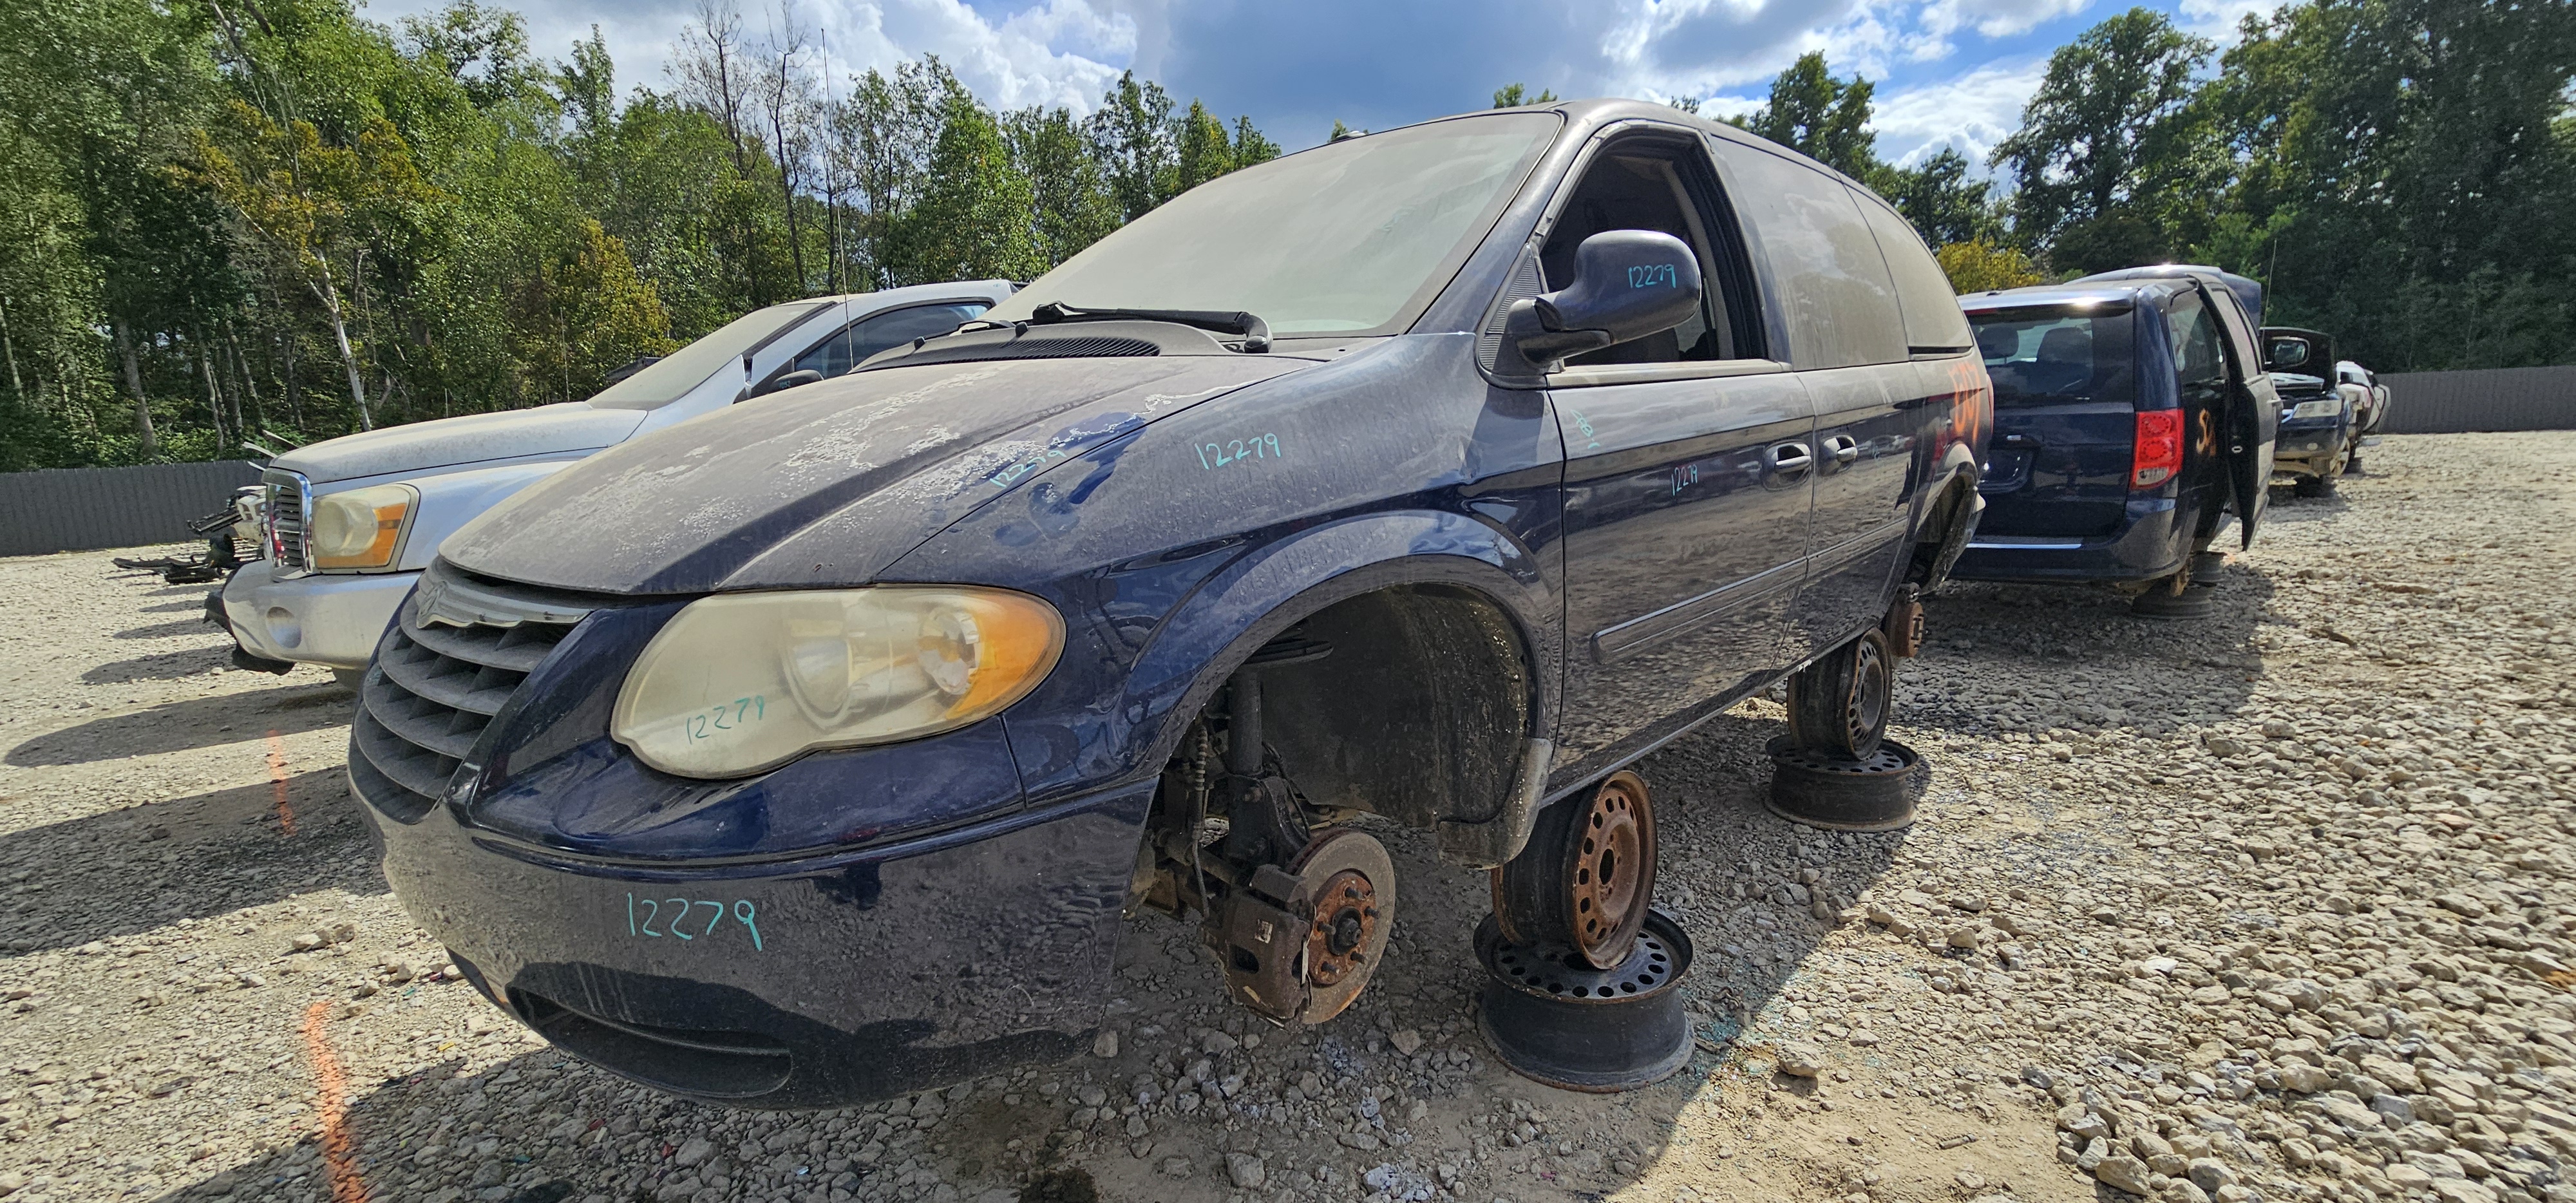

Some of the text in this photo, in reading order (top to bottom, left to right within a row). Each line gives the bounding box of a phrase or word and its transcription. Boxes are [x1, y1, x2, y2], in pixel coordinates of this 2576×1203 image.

[1628, 263, 1676, 289] 12279
[990, 449, 1066, 488] 12279
[1195, 433, 1281, 469] 12279
[1671, 464, 1698, 496] 12279
[687, 695, 765, 745] 12279
[627, 892, 762, 951] 12279
